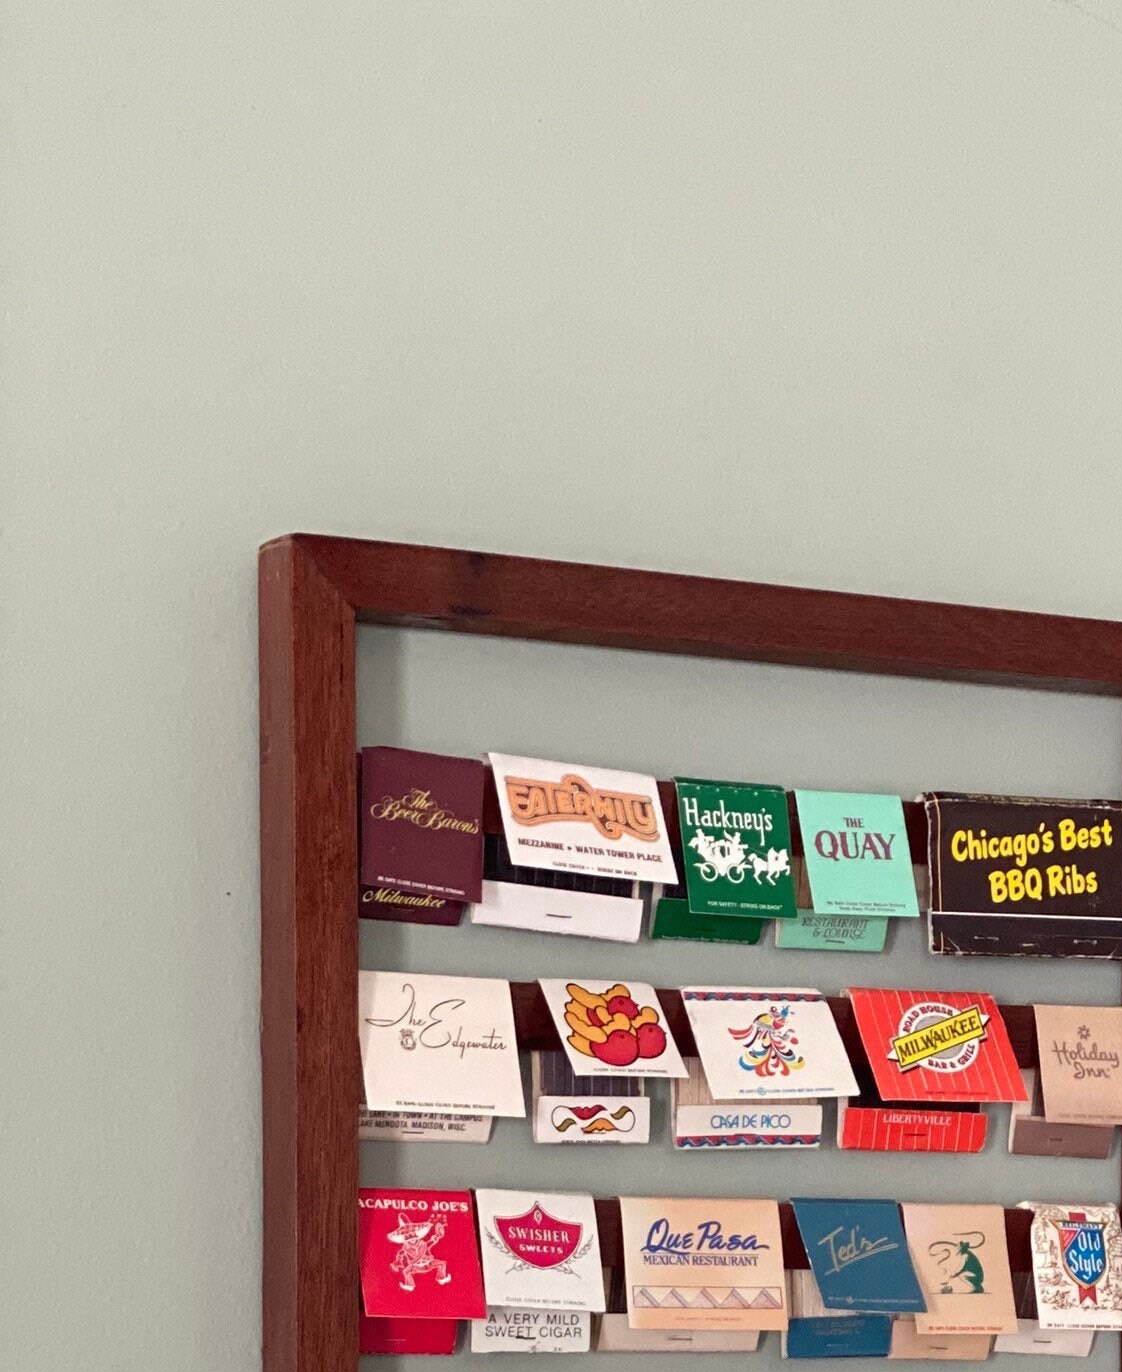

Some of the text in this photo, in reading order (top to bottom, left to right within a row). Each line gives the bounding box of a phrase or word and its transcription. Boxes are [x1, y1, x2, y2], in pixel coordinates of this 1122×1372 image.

[370, 796, 423, 822] Beer
[403, 788, 432, 810] The
[505, 774, 660, 842] EATERNITY
[682, 797, 773, 846] Hackney's
[843, 817, 864, 828] THE
[518, 838, 663, 863] MEZZANINE WATER TOWER PLACE
[814, 829, 896, 861] QUAY
[951, 818, 1113, 867] Chicago's Best
[988, 864, 1098, 904] BBQ Ribs
[362, 888, 446, 908] Milwaukee
[364, 983, 507, 1059] The Edgewater
[903, 1004, 954, 1033] ROAD HOUSE
[898, 1015, 981, 1063] MILWAUKEE
[927, 1058, 947, 1069] BAR
[957, 1044, 976, 1066] GRILL
[1051, 1040, 1120, 1068] Holiday
[1073, 1062, 1110, 1079] Inn
[711, 1114, 791, 1129] CASA DE PICO
[883, 1113, 952, 1126] LIBERTYVILLE
[432, 1201, 469, 1212] JOE'S
[508, 1226, 570, 1244] SWISHER
[641, 1218, 770, 1255] Que Pasa
[1078, 1231, 1101, 1251] Old
[519, 1244, 564, 1254] SWEETS
[643, 1255, 759, 1267] MEXICAN RESTAURANT
[818, 1225, 890, 1272] Ted's
[1069, 1250, 1103, 1280] Style
[485, 1326, 582, 1338] SWEET CIGAR
[488, 1313, 580, 1326] A VERY MILD
